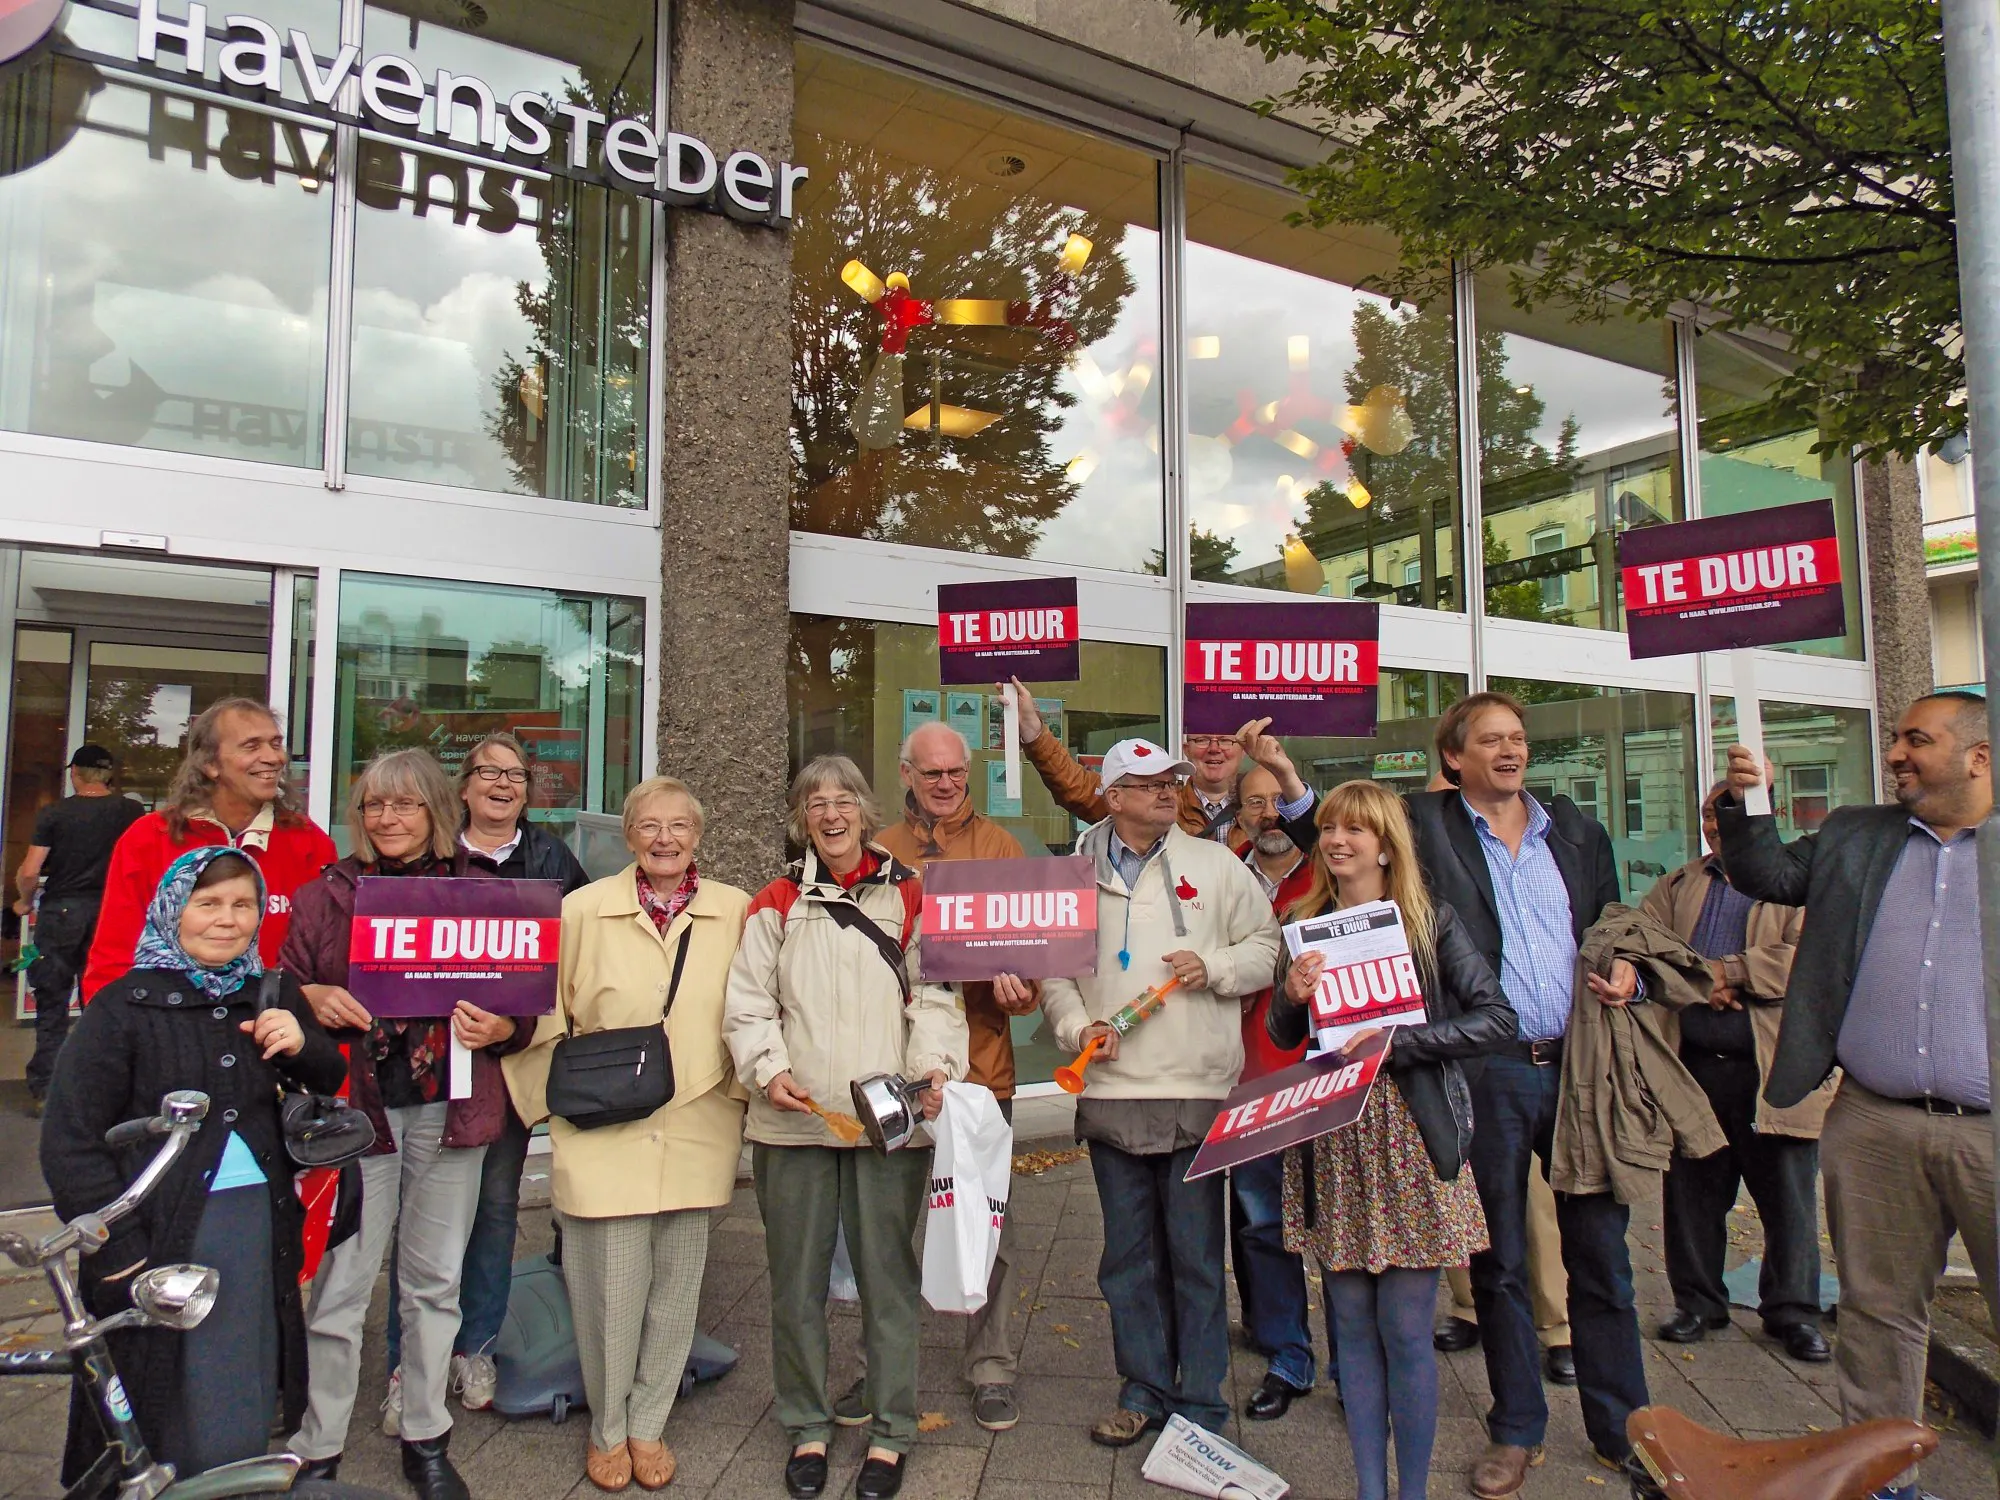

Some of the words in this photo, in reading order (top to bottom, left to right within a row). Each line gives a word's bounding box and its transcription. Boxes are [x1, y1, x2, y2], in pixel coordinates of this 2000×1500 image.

[1638, 562, 1687, 604] TE
[1698, 544, 1818, 597] DUUR
[949, 613, 981, 643] TE
[989, 609, 1065, 642] DUUR
[1689, 610, 1707, 618] NAAR:
[1200, 642, 1242, 681] TE
[1255, 643, 1359, 682] DUUR
[936, 895, 974, 931] TE
[986, 891, 1079, 929] DUUR
[1328, 925, 1342, 938] TE
[1343, 919, 1371, 935] DUUR
[371, 918, 418, 959] TE
[430, 919, 541, 960] DUUR
[1314, 953, 1422, 1015] DUUR
[1222, 1097, 1265, 1134] TE
[1265, 1061, 1364, 1118] DUUR
[1183, 1430, 1237, 1472] Trouw
